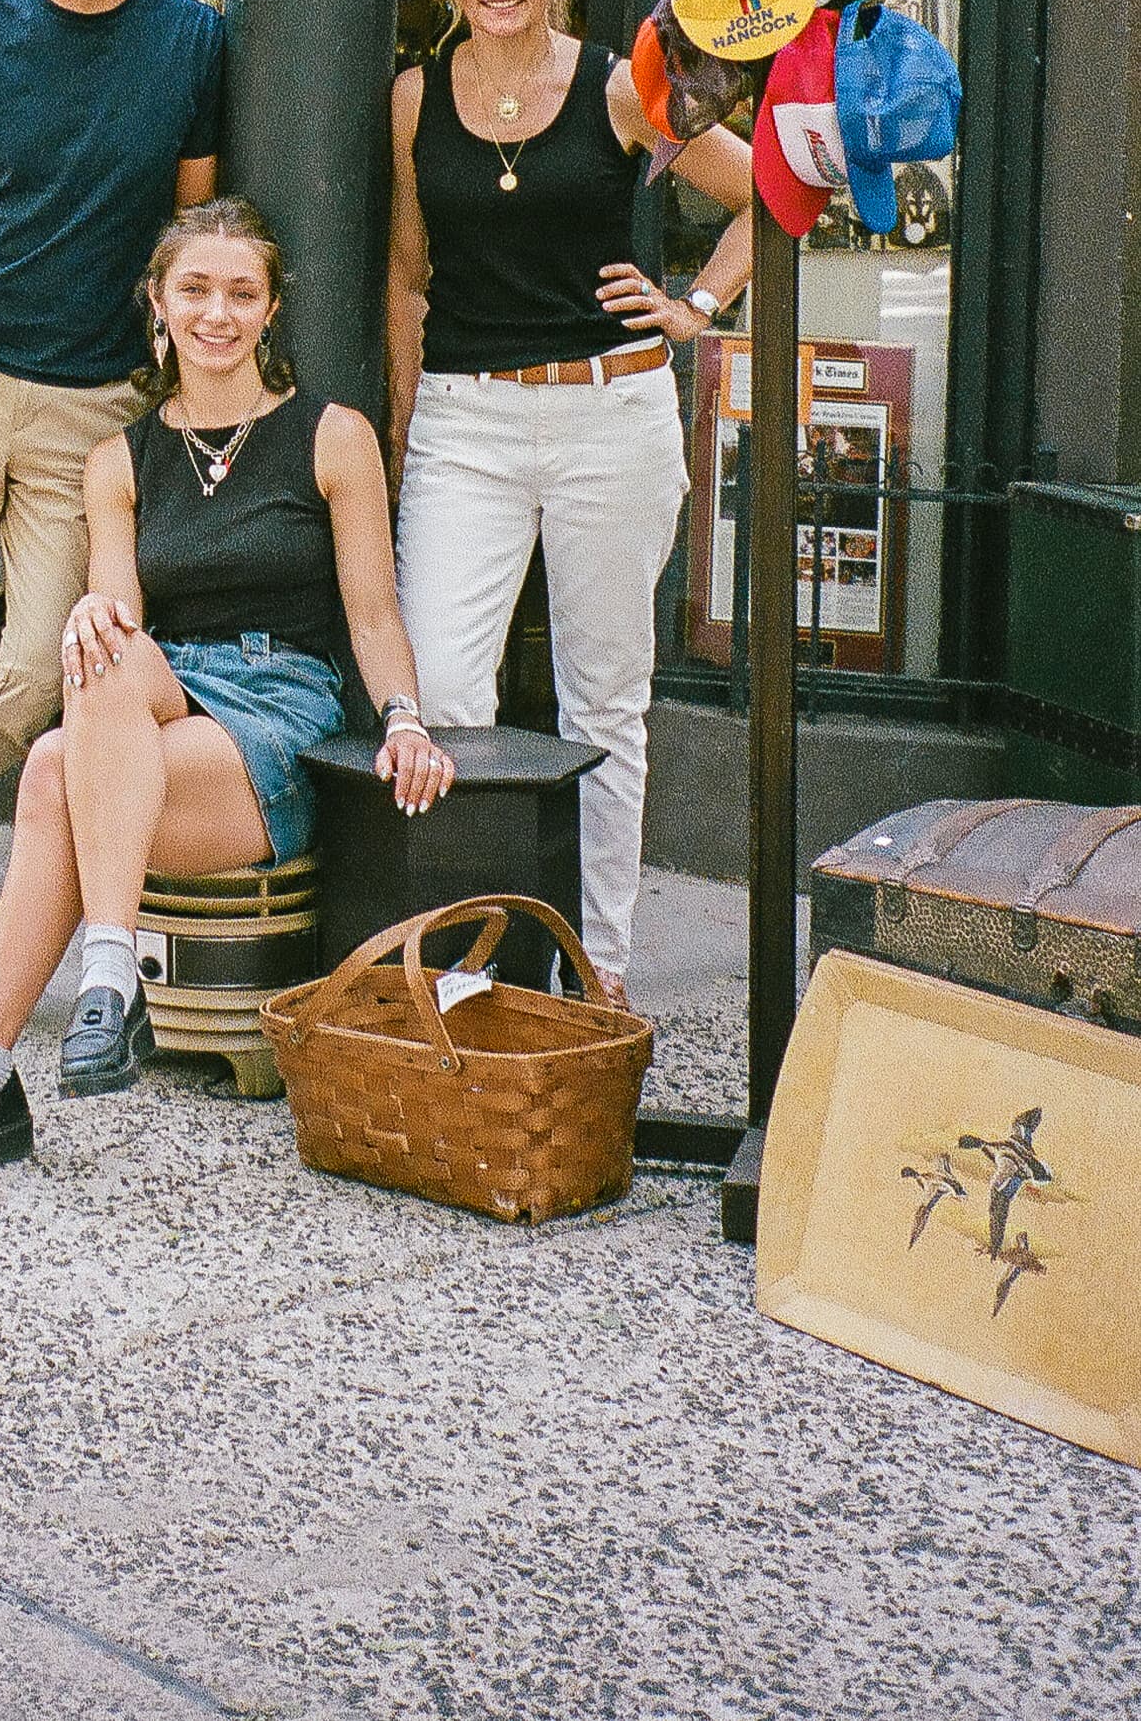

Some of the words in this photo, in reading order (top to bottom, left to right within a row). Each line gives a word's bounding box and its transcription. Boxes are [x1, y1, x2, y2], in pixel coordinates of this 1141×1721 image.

[711, 12, 798, 48] HANCOCK
[726, 8, 773, 32] JOHN
[825, 366, 859, 379] Times
